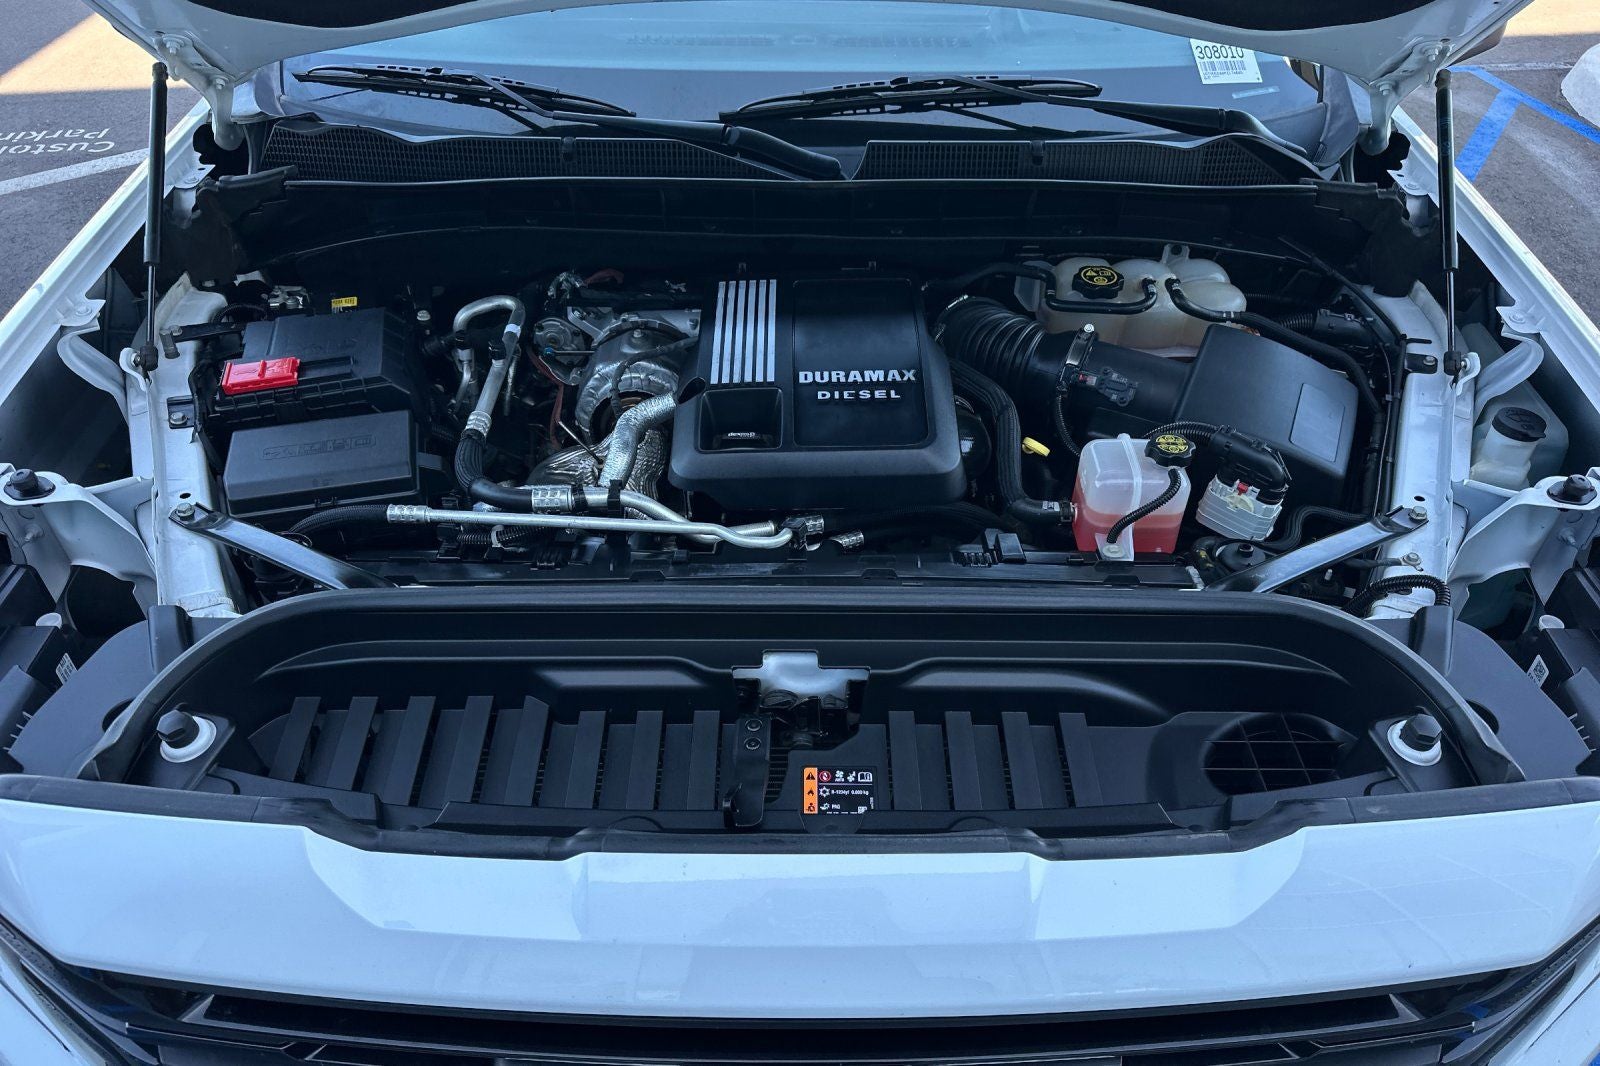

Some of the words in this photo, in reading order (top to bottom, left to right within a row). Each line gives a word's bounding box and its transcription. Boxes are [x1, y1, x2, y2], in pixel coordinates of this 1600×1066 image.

[1195, 45, 1244, 59] 308010
[798, 369, 916, 384] DURAMAX
[817, 389, 901, 400] DIESEL
